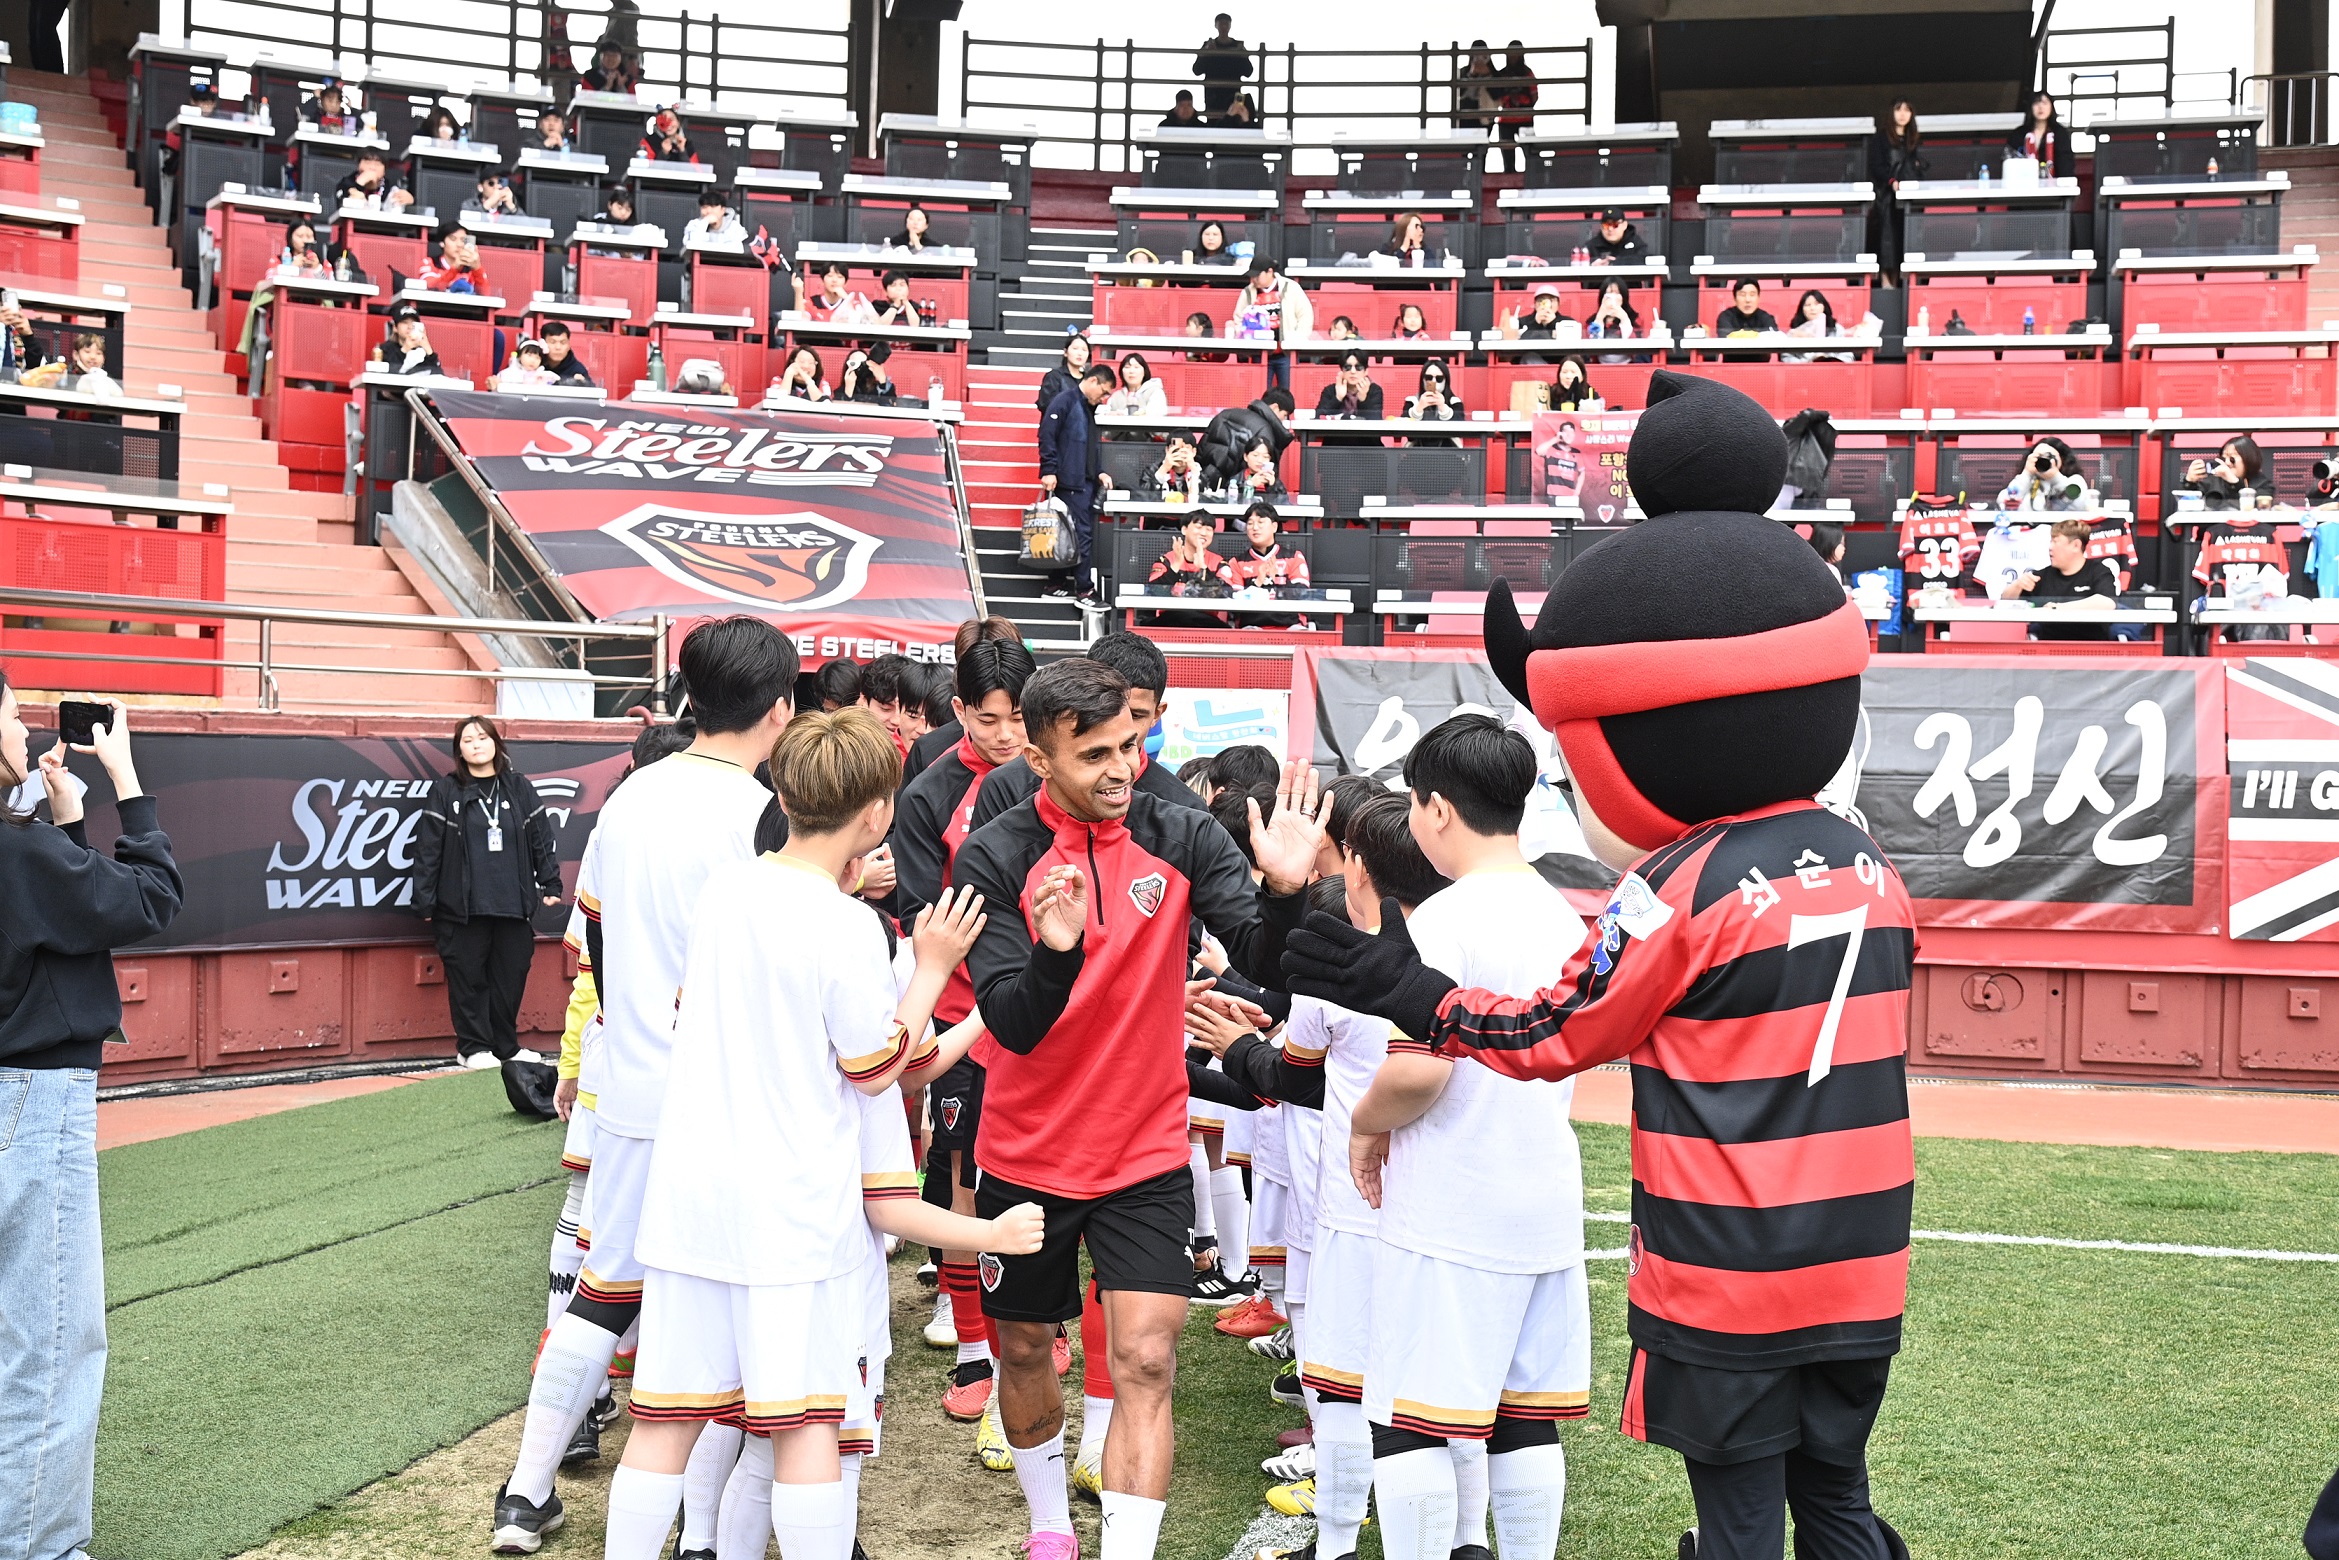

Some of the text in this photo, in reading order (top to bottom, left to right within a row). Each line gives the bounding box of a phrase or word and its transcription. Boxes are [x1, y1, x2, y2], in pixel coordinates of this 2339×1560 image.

[521, 416, 893, 472] Steelers
[614, 419, 730, 436] NEW
[521, 456, 747, 483] WAVE
[647, 522, 836, 549] STEELERS
[1919, 537, 1960, 579] 33
[1912, 695, 2168, 868] 정신
[1787, 903, 1869, 1089] 7
